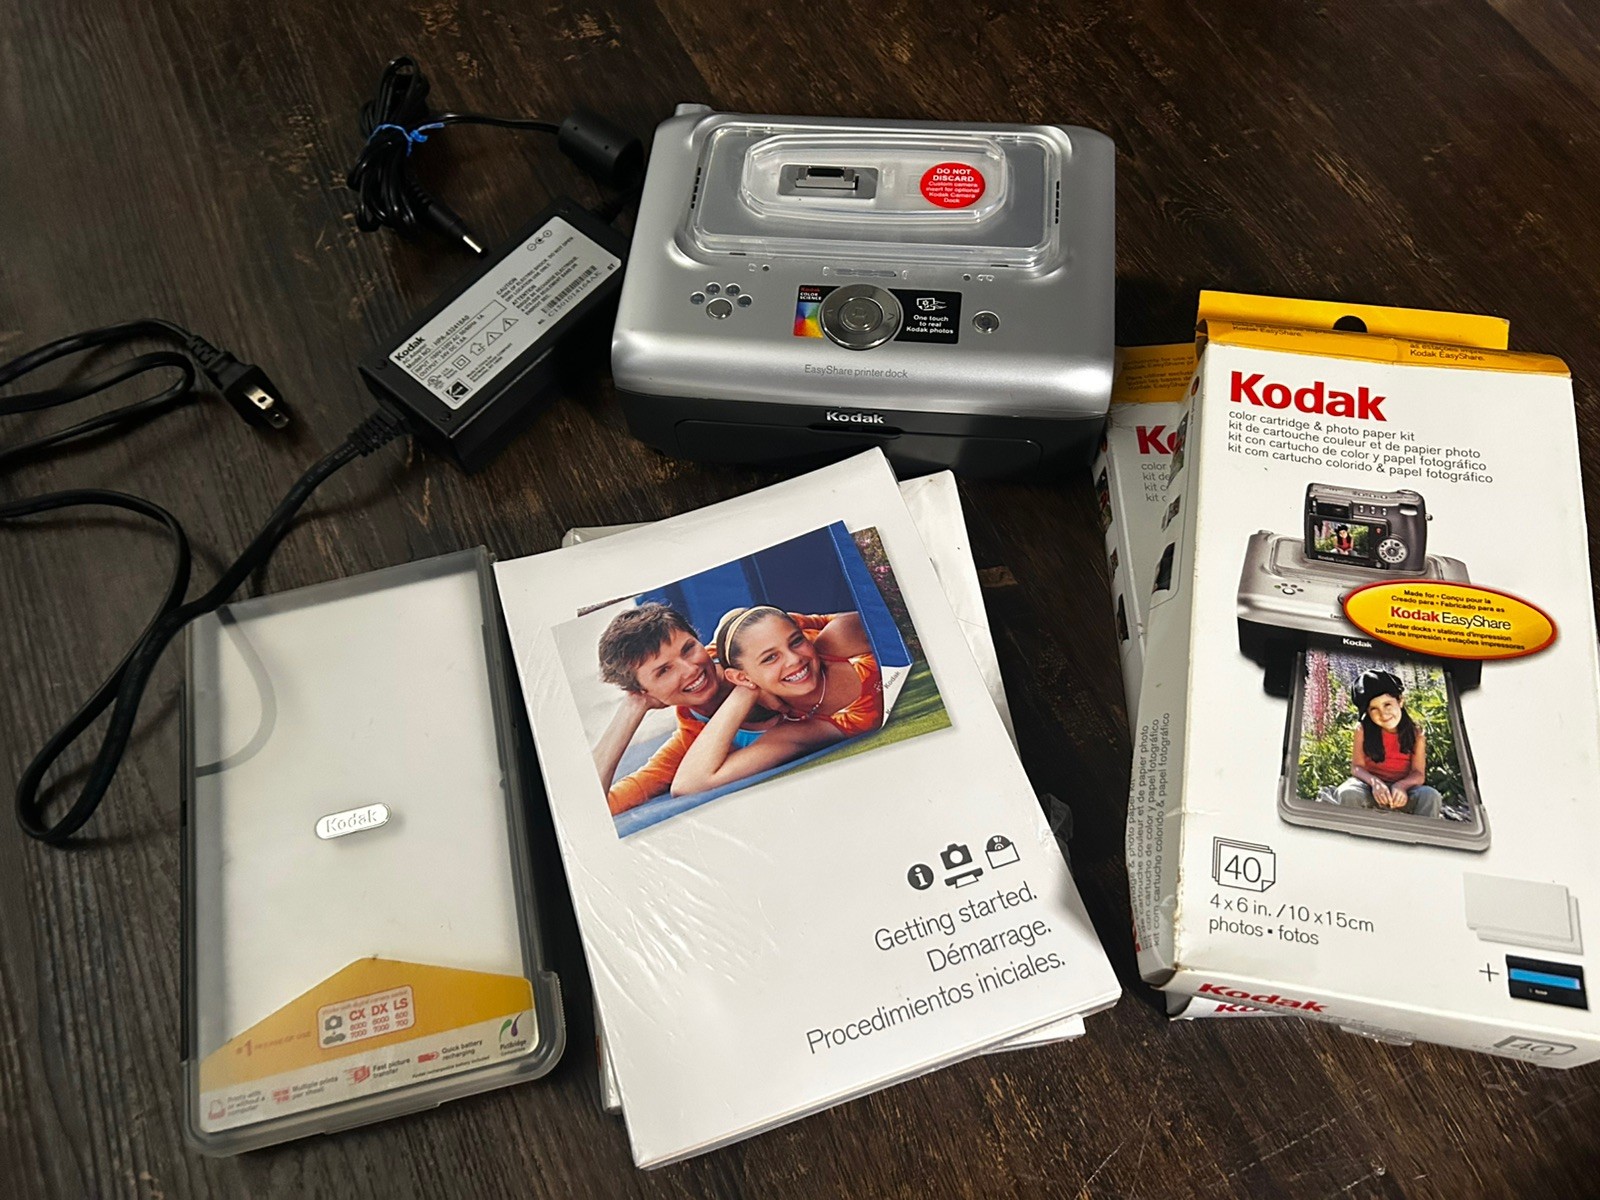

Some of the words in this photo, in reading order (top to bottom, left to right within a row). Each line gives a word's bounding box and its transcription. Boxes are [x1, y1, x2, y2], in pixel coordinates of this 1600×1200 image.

[496, 277, 516, 294] CAUTION
[512, 285, 535, 304] ATTENTION
[394, 336, 424, 360] Kodak
[1410, 349, 1436, 357] Kodak
[1439, 352, 1485, 361] EasyShare.
[804, 365, 853, 378] EasyShare
[854, 368, 883, 380] printer
[885, 368, 908, 379] dock
[1230, 371, 1387, 421] Kodak
[826, 411, 884, 424] Kodak
[1229, 410, 1256, 421] color
[1260, 414, 1310, 431] cartridge
[1314, 420, 1323, 431] &
[1326, 423, 1359, 437] photo
[1363, 429, 1397, 442] paper
[1400, 431, 1415, 441] kit
[1228, 432, 1242, 442] kit
[1246, 436, 1266, 445] con
[1269, 438, 1319, 453] cartucho
[1323, 445, 1337, 455] de
[1341, 448, 1369, 460] color
[1372, 453, 1380, 464] y
[1384, 453, 1416, 467] papel
[1420, 455, 1487, 471] fotográfico
[1229, 420, 1242, 431] kit
[1246, 423, 1260, 433] de
[1263, 427, 1320, 443] cartouche
[1323, 434, 1366, 448] couleur
[1370, 440, 1382, 450] et
[1385, 441, 1400, 451] de
[1404, 444, 1442, 458] papier
[1445, 447, 1481, 461] photo
[1141, 462, 1166, 471] color
[1228, 443, 1242, 454] kit
[1245, 447, 1269, 458] com
[1272, 450, 1322, 466] cartucho
[1326, 458, 1373, 472] colorido
[1376, 462, 1386, 473] &
[1389, 465, 1422, 479] papel
[1426, 468, 1493, 484] fotográfico
[1142, 472, 1155, 481] kit
[1144, 483, 1157, 492] kit
[1146, 493, 1159, 502] kit
[1391, 595, 1416, 603] Creado
[1418, 599, 1434, 607] para
[1440, 601, 1476, 611] Fabricado
[1441, 593, 1464, 603] Conçu
[1466, 597, 1482, 605] pour
[1391, 606, 1439, 623] Kodak
[1442, 612, 1511, 630] EasyShare
[1342, 637, 1372, 648] Kodak
[1375, 627, 1396, 636] bases
[1408, 631, 1442, 641] impresión
[1447, 637, 1479, 646] estações
[1481, 639, 1525, 650] impressoras
[1387, 622, 1409, 631] printer
[1411, 625, 1432, 633] docks
[1437, 628, 1467, 636] stations
[1468, 631, 1512, 641] d'impression
[884, 671, 900, 689] Kodak
[1139, 725, 1149, 753] photo
[1148, 719, 1159, 772] fotográfico
[1158, 713, 1170, 766] fotográfico
[1139, 756, 1147, 787] papier
[1157, 769, 1167, 796] papel
[1137, 790, 1145, 802] de
[1148, 775, 1157, 802] papel
[1127, 795, 1138, 823] paper
[1137, 806, 1144, 816] et
[1157, 800, 1164, 808] &
[327, 810, 376, 832] Kodak
[1156, 810, 1165, 852] colorido
[1126, 827, 1136, 857] photo
[1136, 819, 1144, 857] couleur
[1145, 843, 1152, 857] de
[1153, 855, 1162, 902] cartucho
[1224, 854, 1262, 883] 40
[1136, 861, 1144, 915] cartouche
[1144, 860, 1152, 906] cartucho
[874, 911, 956, 951] Getting
[958, 880, 1038, 923] started.
[1210, 893, 1220, 908] 4
[1224, 900, 1233, 911] x
[1237, 897, 1248, 913] 6
[1253, 900, 1272, 917] in.
[1209, 916, 1263, 937] photos
[1278, 925, 1319, 945] fotos
[926, 920, 1052, 973] Démarrage.
[349, 1009, 366, 1020] CX
[370, 1003, 389, 1015] DX
[393, 998, 408, 1009] LS
[806, 982, 974, 1054] Procedimientos
[976, 951, 1066, 994] iniciales.
[1198, 984, 1329, 1012] Kodak
[373, 1024, 390, 1033] 7000
[395, 1019, 409, 1027] 700
[441, 1045, 459, 1054] Quick
[461, 1039, 483, 1049] battery
[442, 1048, 476, 1060] recharging
[499, 1038, 527, 1050] PictBridge
[373, 1063, 387, 1072] Fast
[388, 1058, 411, 1068] picture
[373, 1068, 398, 1078] transfer
[319, 1076, 338, 1085] prints
